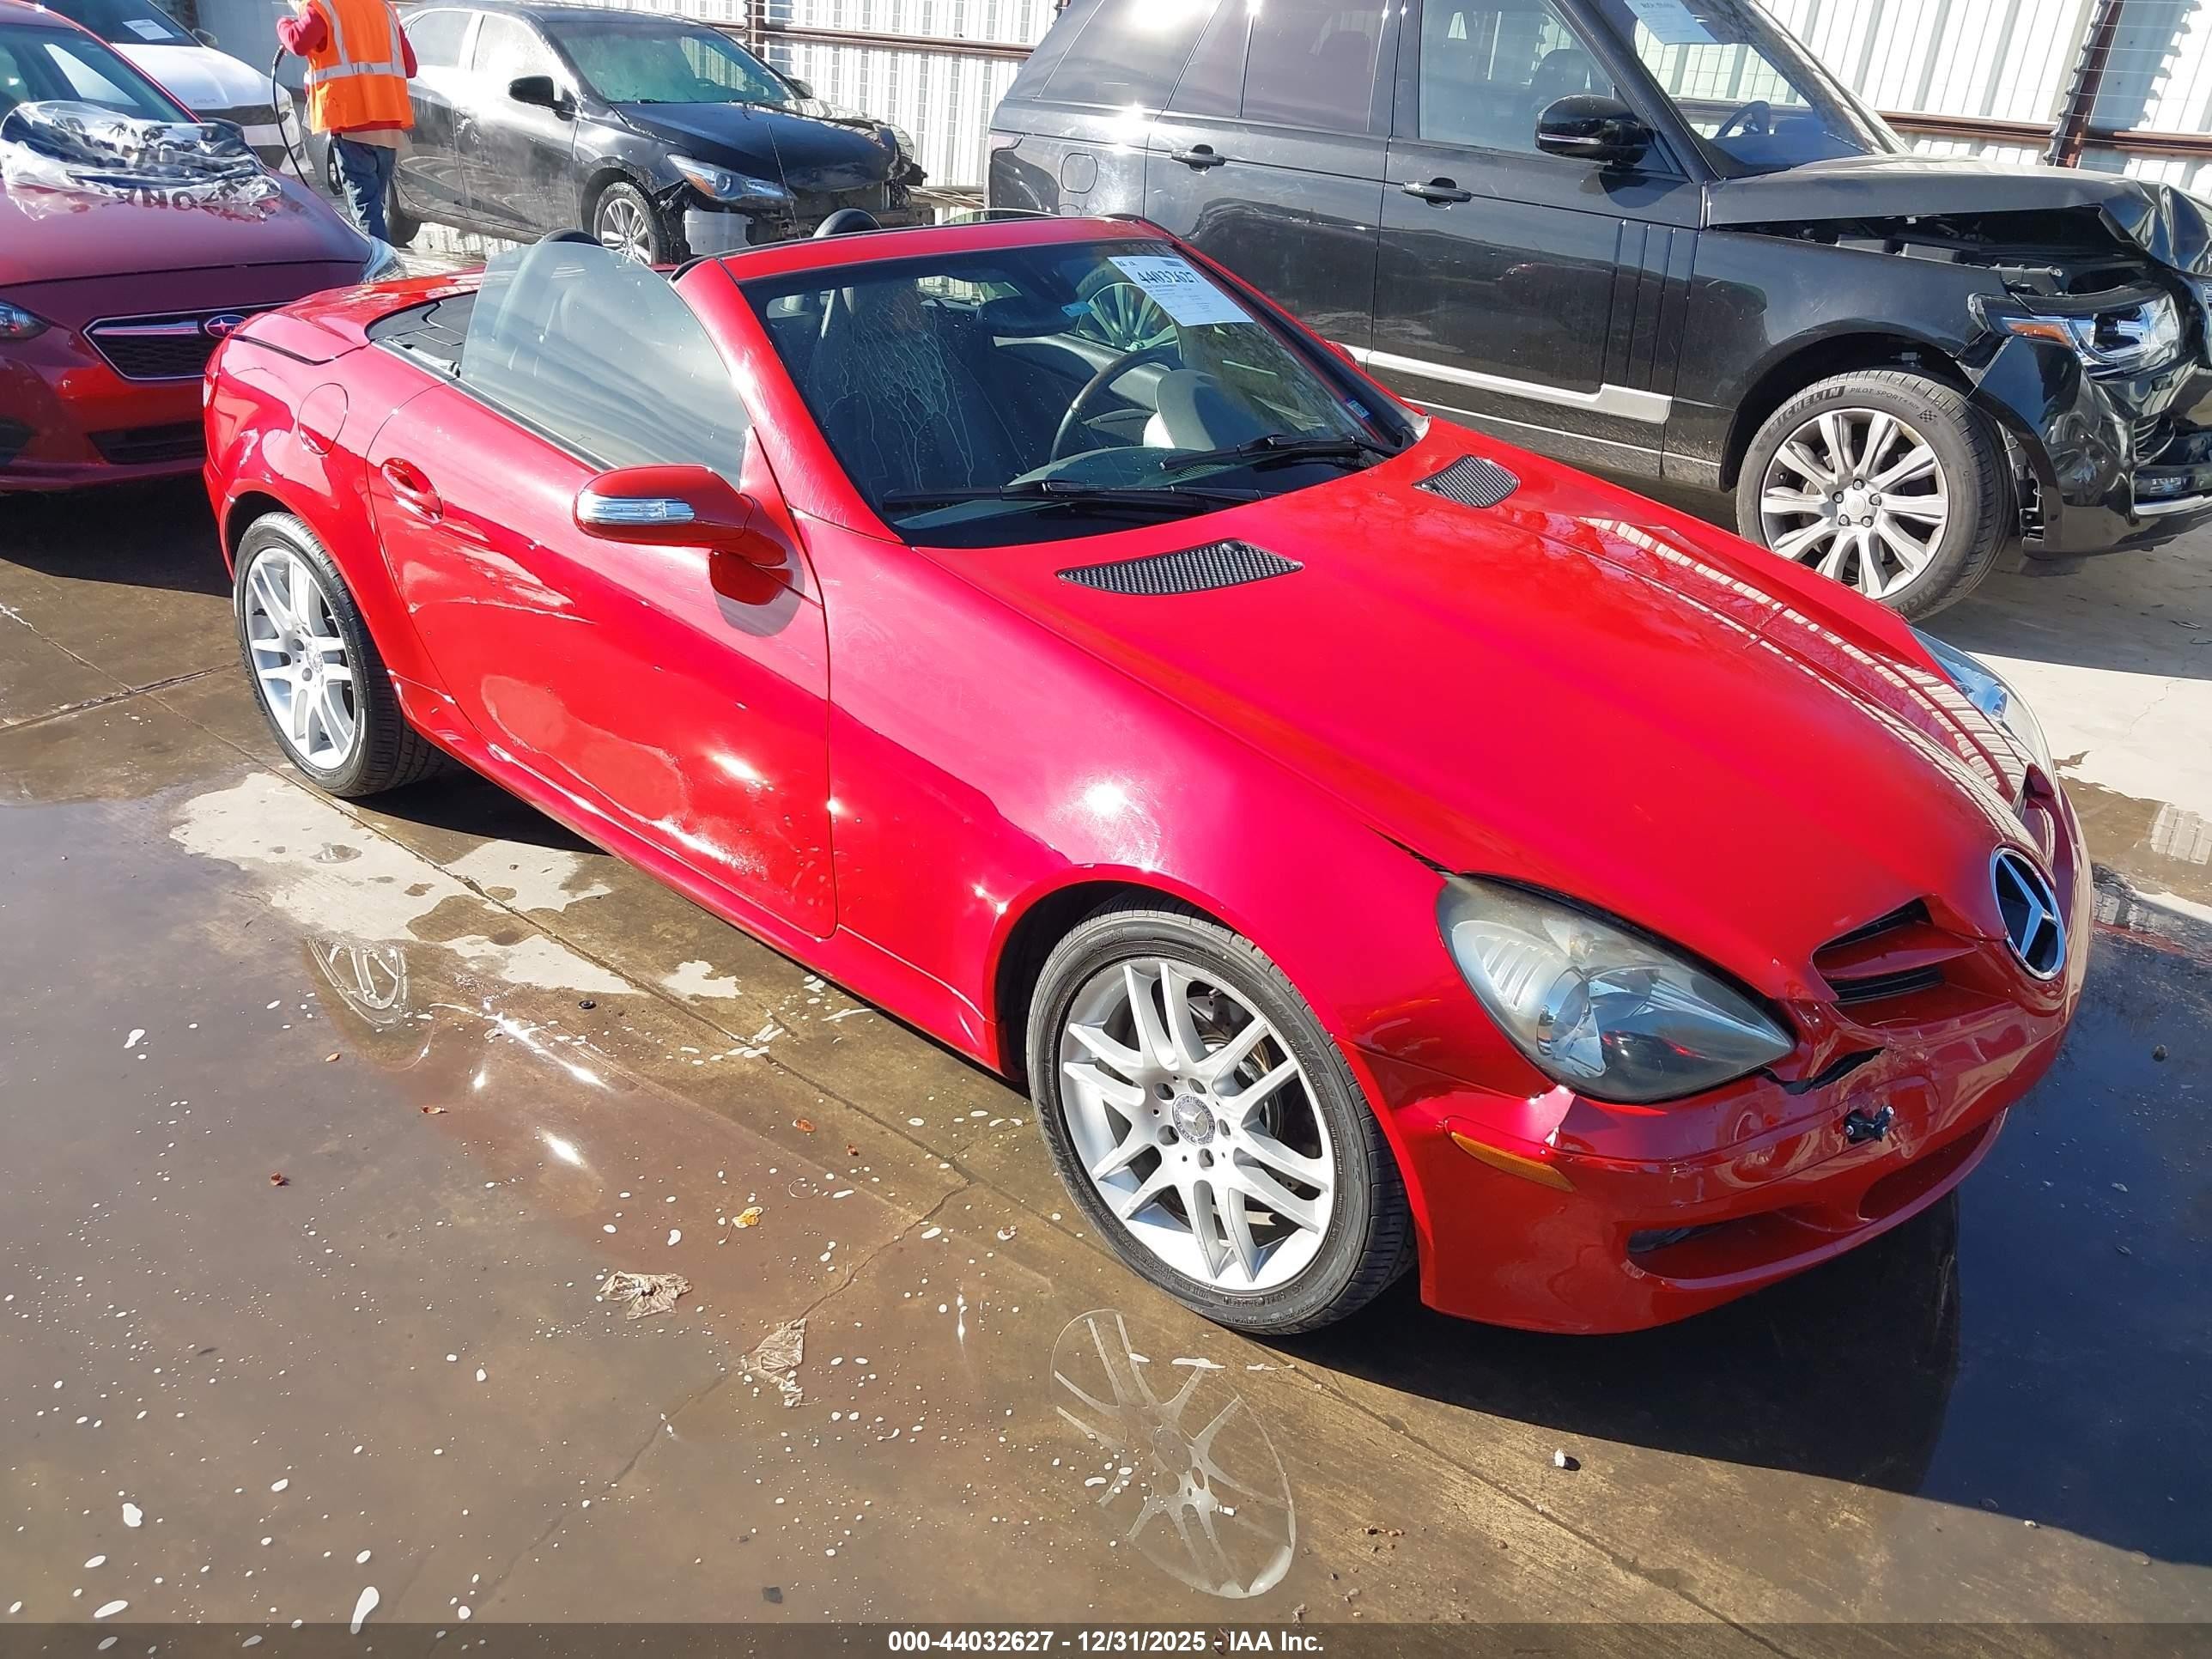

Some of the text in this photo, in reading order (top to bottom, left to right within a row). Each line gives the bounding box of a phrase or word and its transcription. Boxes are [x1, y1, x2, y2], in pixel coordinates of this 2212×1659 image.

[1137, 270, 1200, 284] 44032627
[1876, 390, 1903, 402] SPORT
[1770, 386, 1841, 433] MICHELIN
